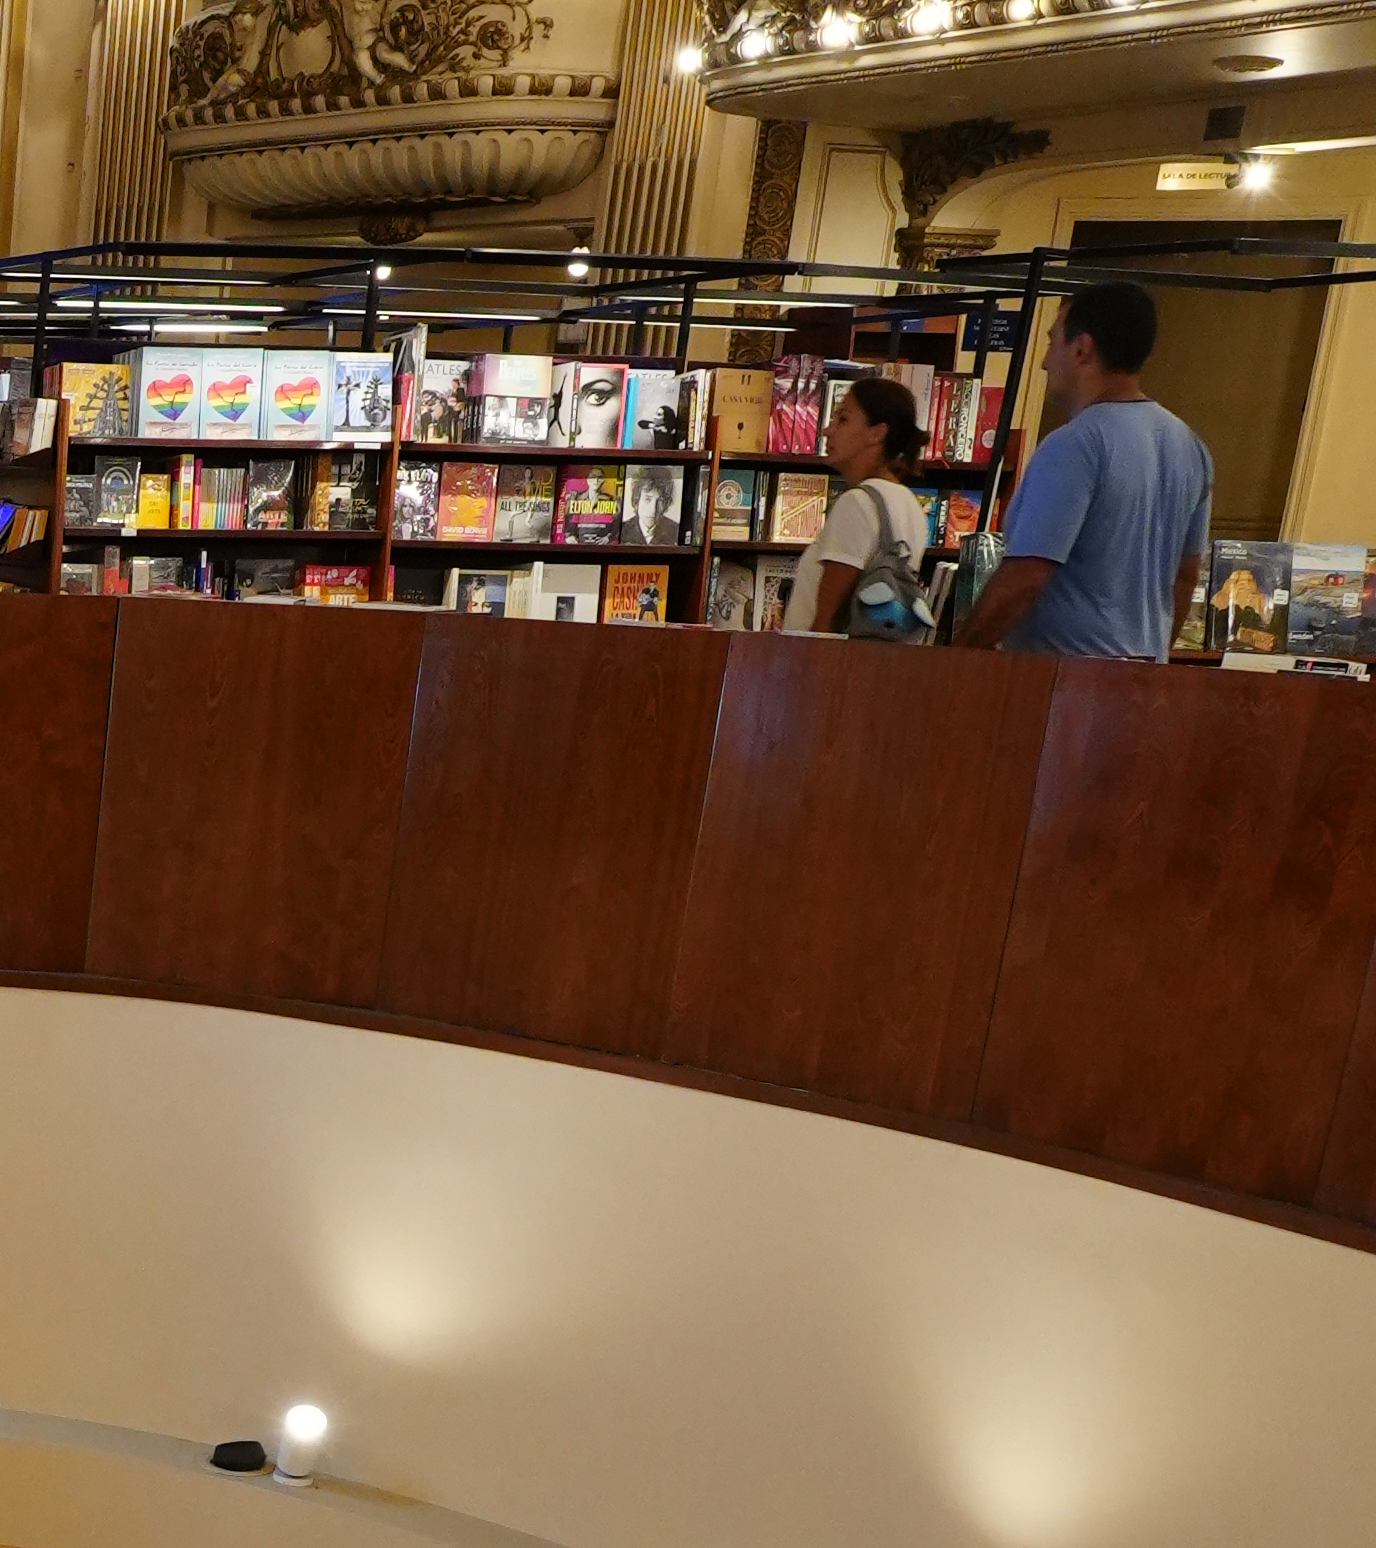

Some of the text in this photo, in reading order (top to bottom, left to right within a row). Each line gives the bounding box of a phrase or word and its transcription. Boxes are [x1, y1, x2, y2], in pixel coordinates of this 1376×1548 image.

[1162, 172, 1184, 180] SALA
[1185, 172, 1197, 180] DE
[424, 363, 462, 378] ATLES
[570, 499, 617, 515] ELTON JOHN
[442, 525, 488, 536] DAVID BOWIE
[614, 569, 661, 585] JOHNNY
[328, 594, 357, 607] ARTE
